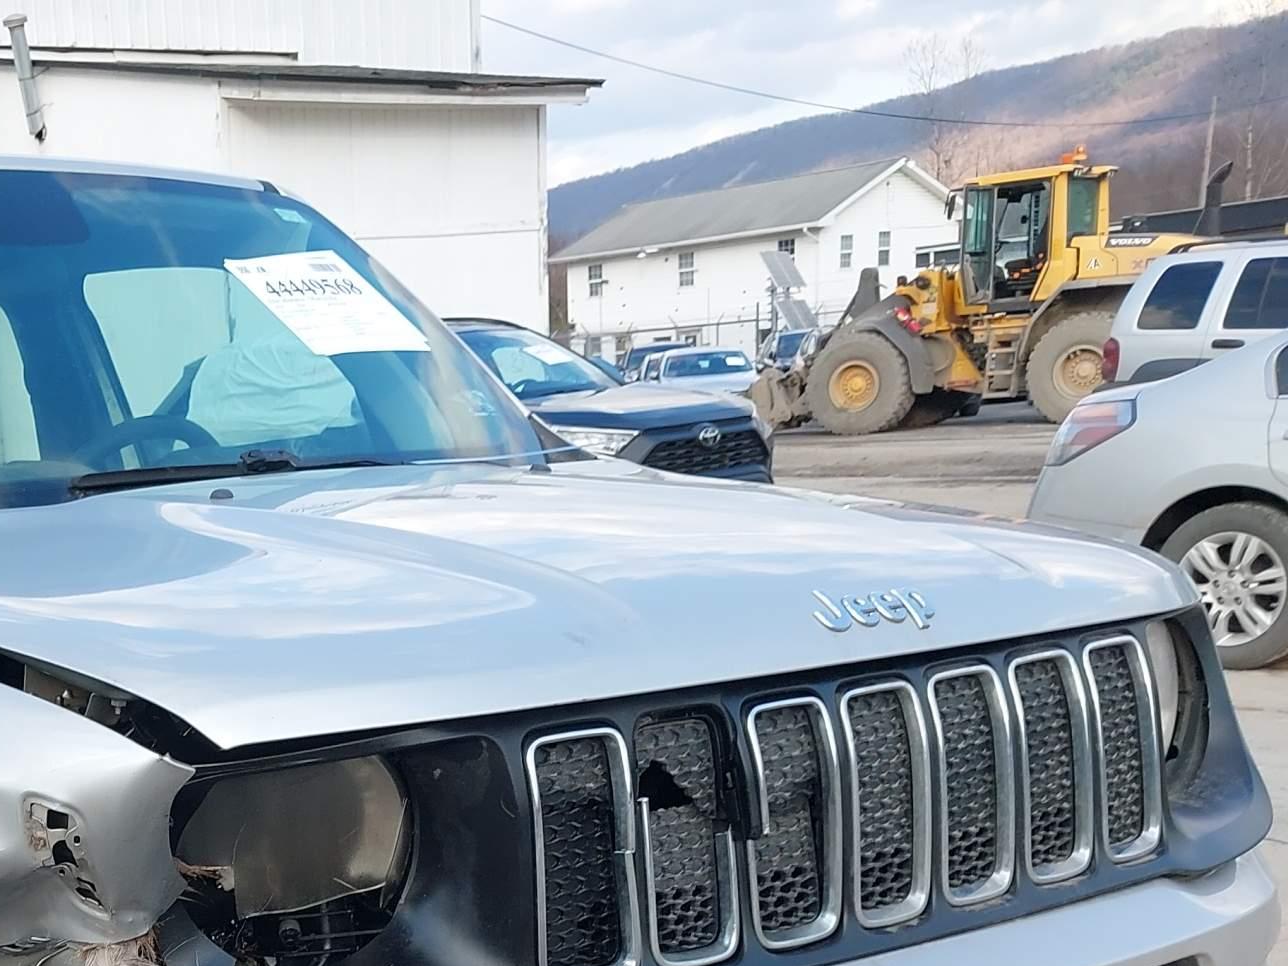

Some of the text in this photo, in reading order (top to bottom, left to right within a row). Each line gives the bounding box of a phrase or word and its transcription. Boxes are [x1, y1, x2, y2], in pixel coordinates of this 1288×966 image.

[1109, 238, 1153, 246] VOLVO
[265, 278, 363, 297] 44449568
[811, 587, 935, 633] Jeep
